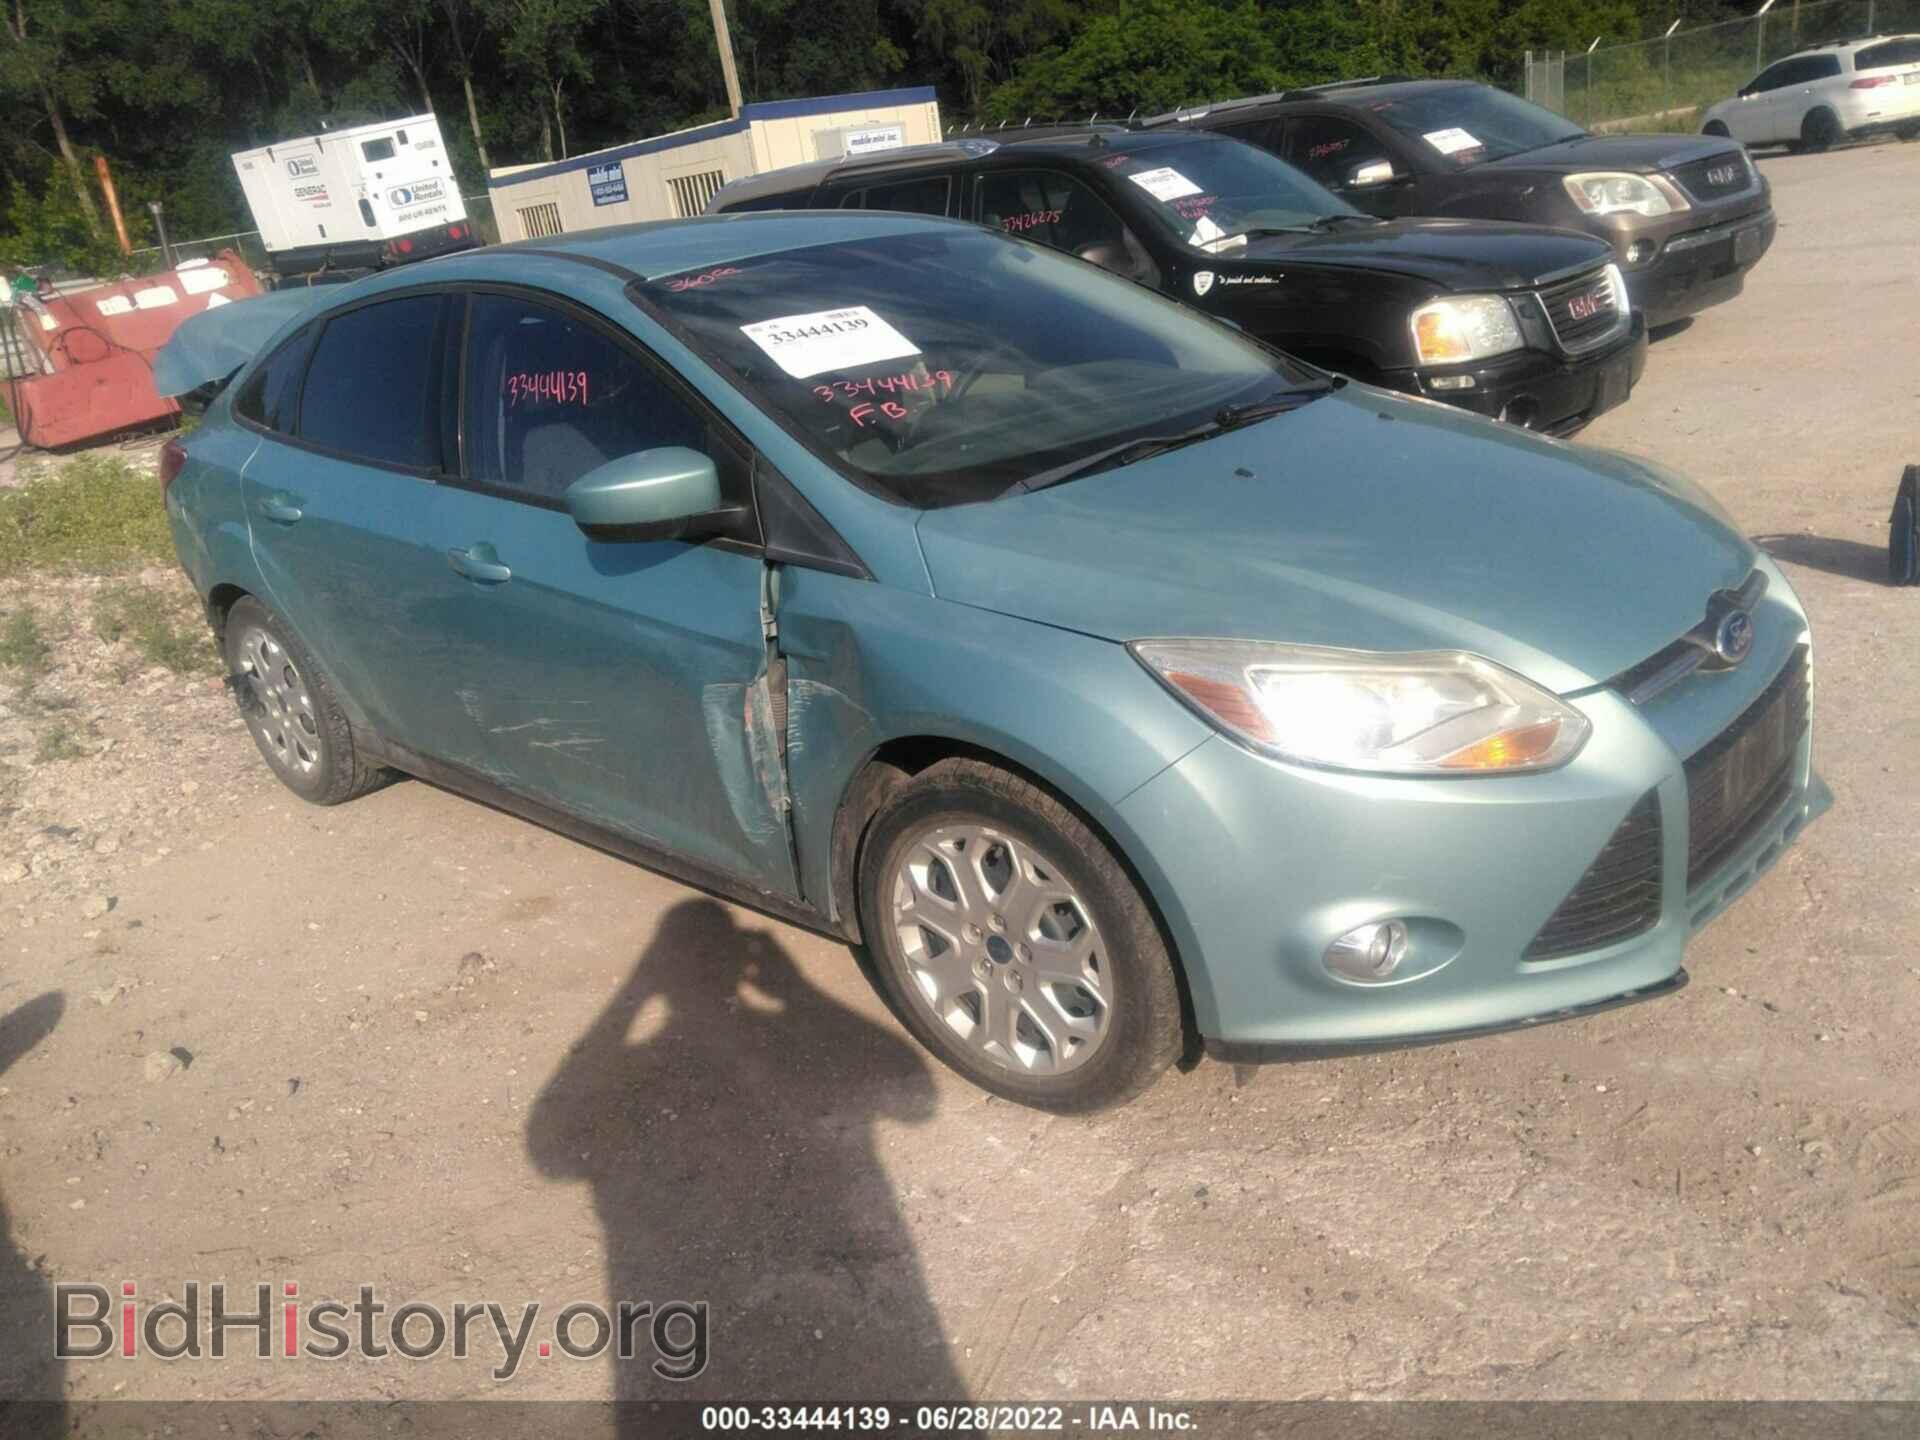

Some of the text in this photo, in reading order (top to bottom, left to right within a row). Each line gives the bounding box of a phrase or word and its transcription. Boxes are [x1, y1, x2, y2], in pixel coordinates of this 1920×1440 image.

[411, 181, 438, 193] United
[413, 189, 443, 201] Rentals
[768, 318, 869, 345] 33444139
[508, 371, 587, 406] 33444139
[814, 370, 951, 402] 33444139
